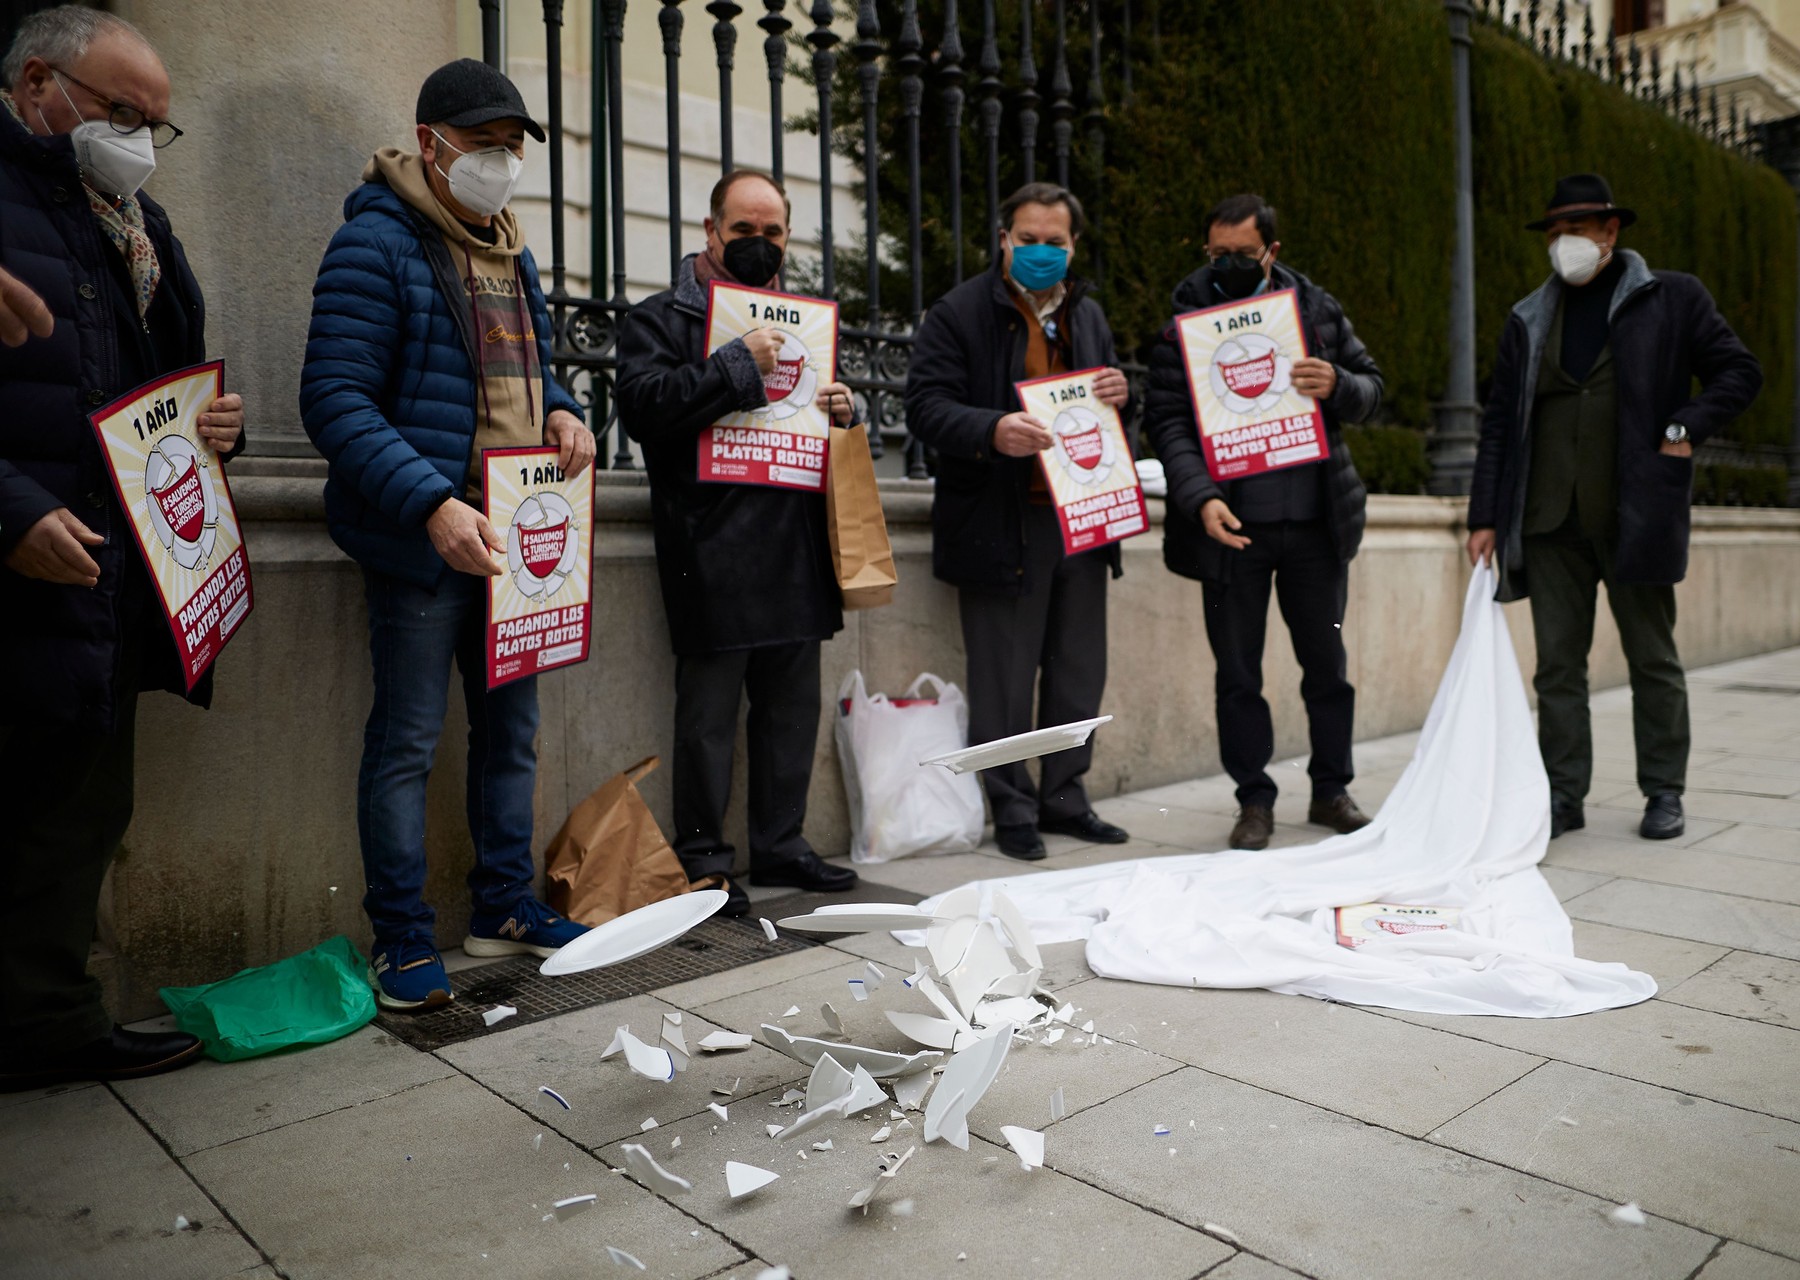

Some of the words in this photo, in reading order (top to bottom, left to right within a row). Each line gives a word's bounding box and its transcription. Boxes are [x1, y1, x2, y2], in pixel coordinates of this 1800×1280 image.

[750, 303, 757, 318] 1
[764, 304, 800, 324] AÑO
[1214, 320, 1222, 333] 1
[1228, 311, 1262, 330] AÑO
[1049, 391, 1057, 404] 1
[1061, 384, 1086, 401] AÑO
[133, 418, 144, 440] 1
[146, 397, 178, 434] AÑO
[1212, 421, 1283, 448] PAGANDO
[1285, 414, 1313, 431] LOS
[712, 428, 792, 449] PAGANDO
[796, 436, 824, 454] LOS
[712, 444, 772, 462] PLATOS
[776, 450, 823, 470] ROTOS
[1215, 439, 1267, 462] PLATOS
[1269, 428, 1316, 450] ROTOS
[520, 468, 528, 485] 1
[162, 475, 198, 512] #SALVEMOS
[168, 514, 175, 524] EL
[172, 492, 198, 518] TURISMO
[196, 490, 202, 498] Y
[1064, 493, 1117, 519] PAGANDO
[1116, 486, 1138, 504] LOS
[523, 530, 564, 546] #SALVEMOS
[1068, 510, 1108, 534] PLATOS
[524, 548, 529, 556] EL
[530, 543, 558, 556] TURISMO
[557, 542, 563, 551] Y
[179, 570, 226, 632] PAGANDO
[225, 550, 243, 581] LOS
[186, 602, 220, 654] PLATOS
[220, 570, 246, 613] ROTOS
[497, 610, 559, 640] PAGANDO
[562, 605, 584, 624] LOS
[496, 633, 542, 659] PLATOS
[545, 623, 583, 646] ROTOS
